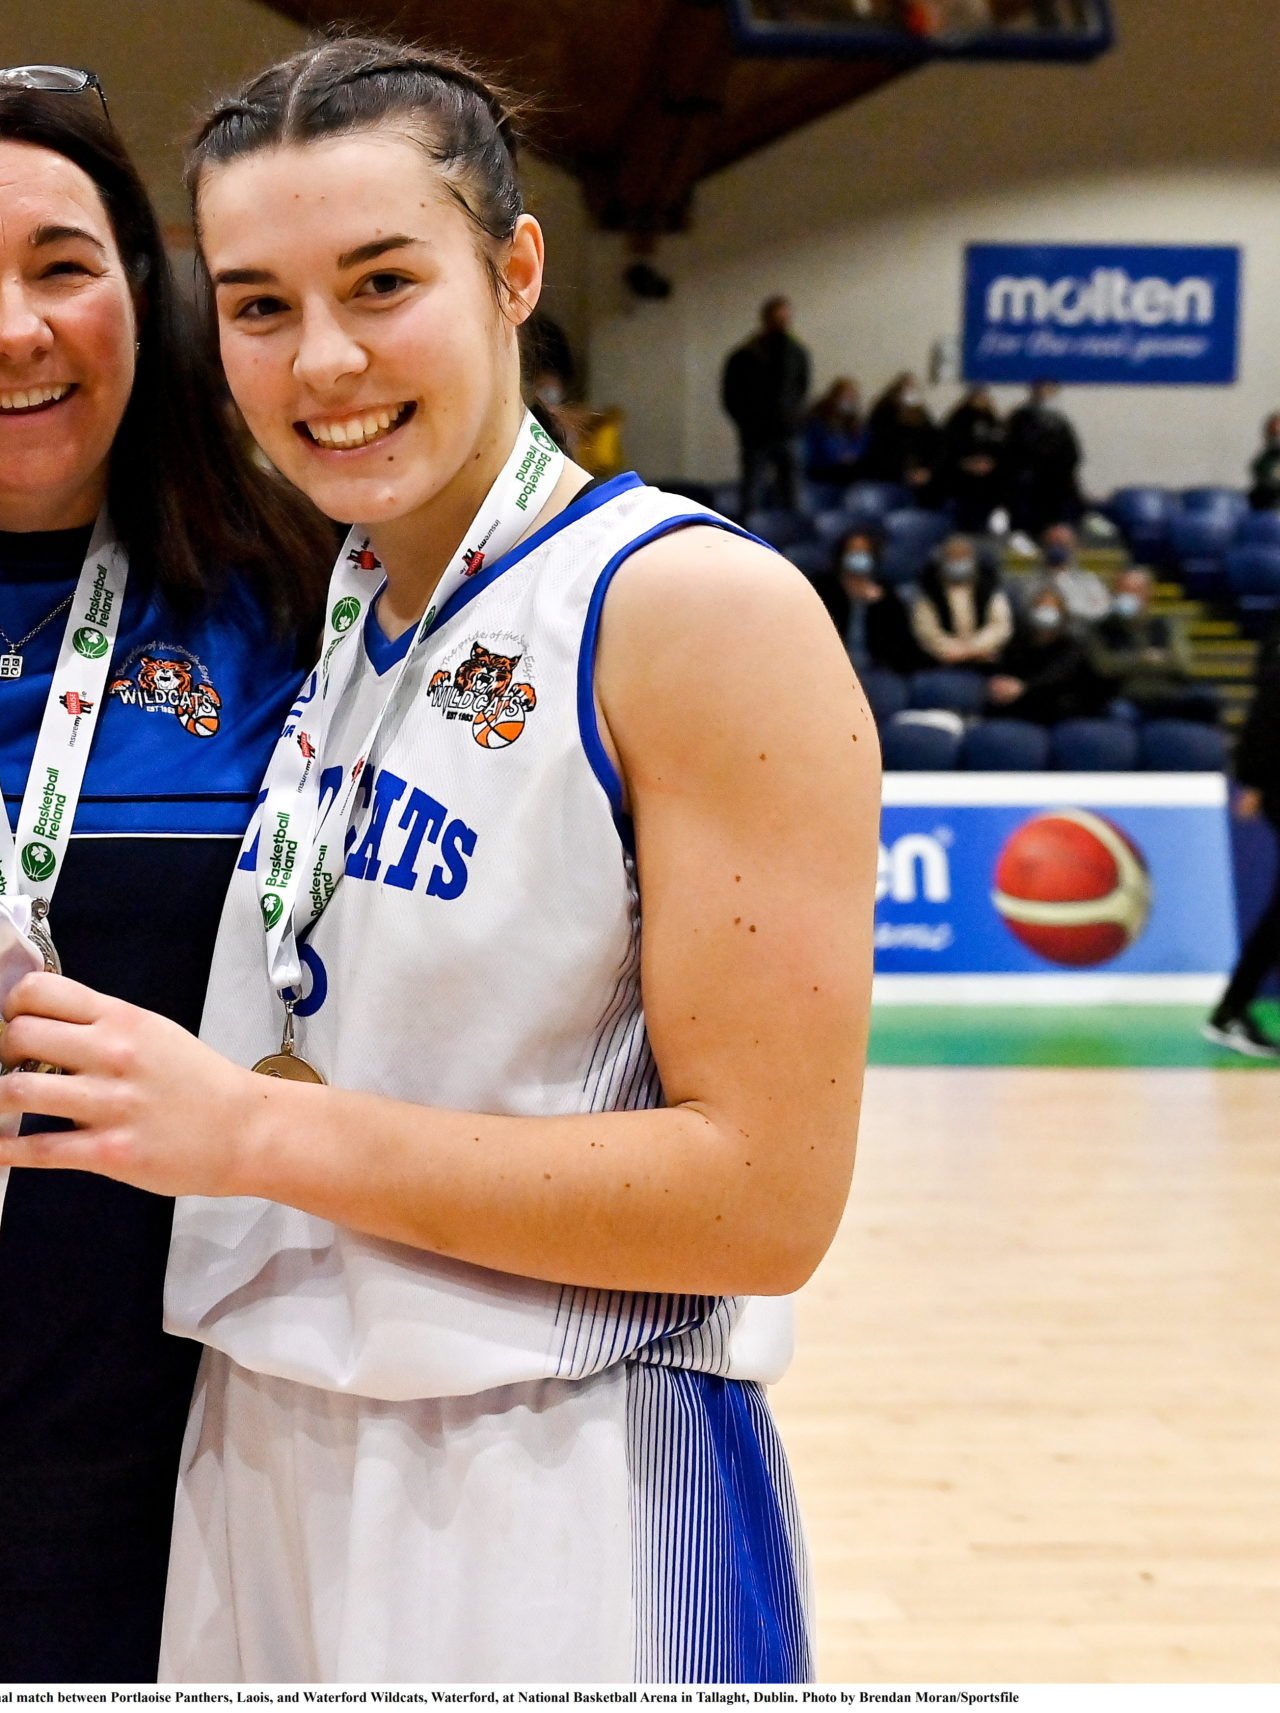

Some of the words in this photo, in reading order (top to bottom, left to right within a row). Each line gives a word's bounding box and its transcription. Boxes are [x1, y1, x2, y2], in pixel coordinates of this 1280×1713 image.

[986, 267, 1213, 326] molten
[515, 444, 537, 483] Ireland
[515, 451, 551, 512] Basketball
[84, 563, 108, 623] Basketball
[96, 589, 114, 628] Ireland
[120, 689, 212, 717] WILDCATS
[431, 685, 522, 718] WILDCATS
[68, 715, 82, 748] insuremy
[32, 767, 60, 837] Basketball
[45, 793, 67, 841] Ireland
[265, 812, 291, 887] Basketball
[342, 768, 478, 901] ATS
[279, 840, 298, 888] Ireland
